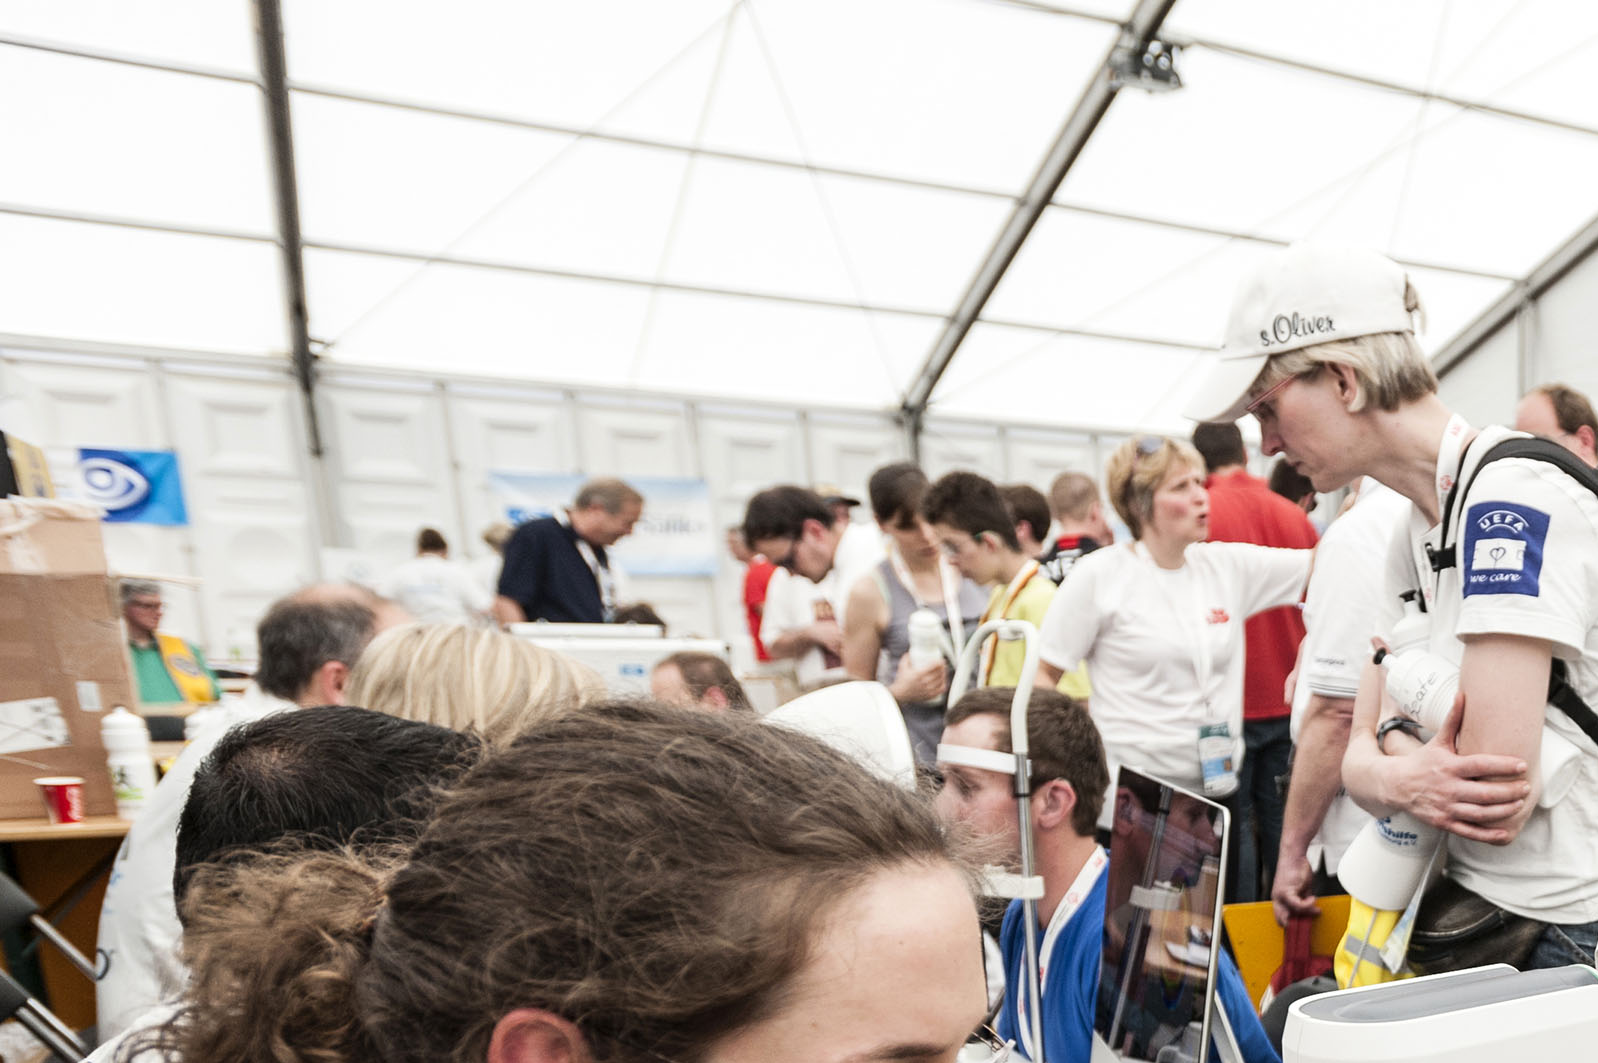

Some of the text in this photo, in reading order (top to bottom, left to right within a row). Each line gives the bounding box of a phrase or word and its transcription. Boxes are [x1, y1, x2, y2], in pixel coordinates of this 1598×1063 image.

[1260, 311, 1336, 347] s.Oliver
[1480, 513, 1525, 531] UEFA
[1470, 573, 1522, 583] we care
